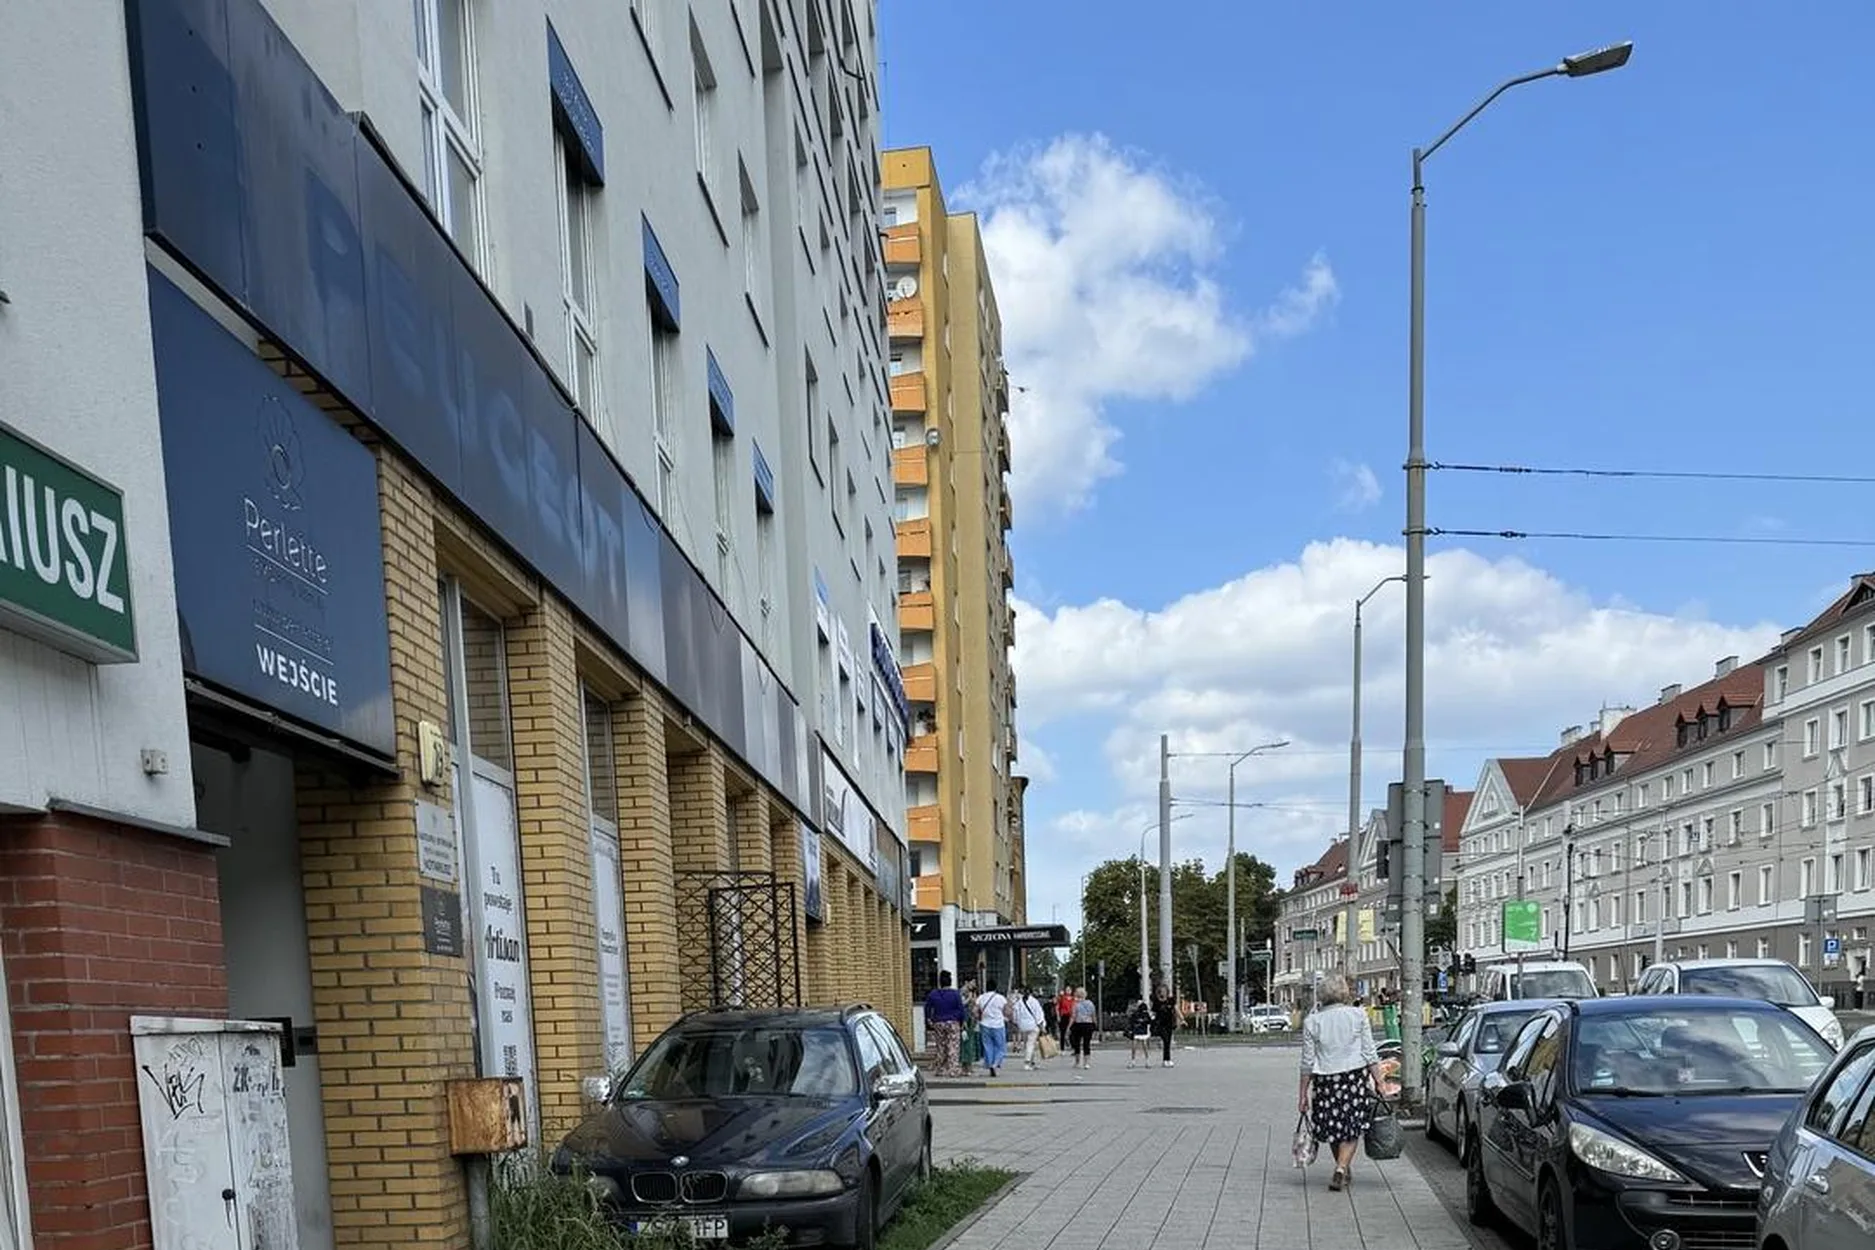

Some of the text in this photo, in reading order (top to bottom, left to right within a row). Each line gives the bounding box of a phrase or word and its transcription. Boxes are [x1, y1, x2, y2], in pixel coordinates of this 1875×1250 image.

[0, 465, 125, 614] IUSZ
[244, 498, 327, 583] Perlette
[256, 642, 339, 706] WEJŚCIE
